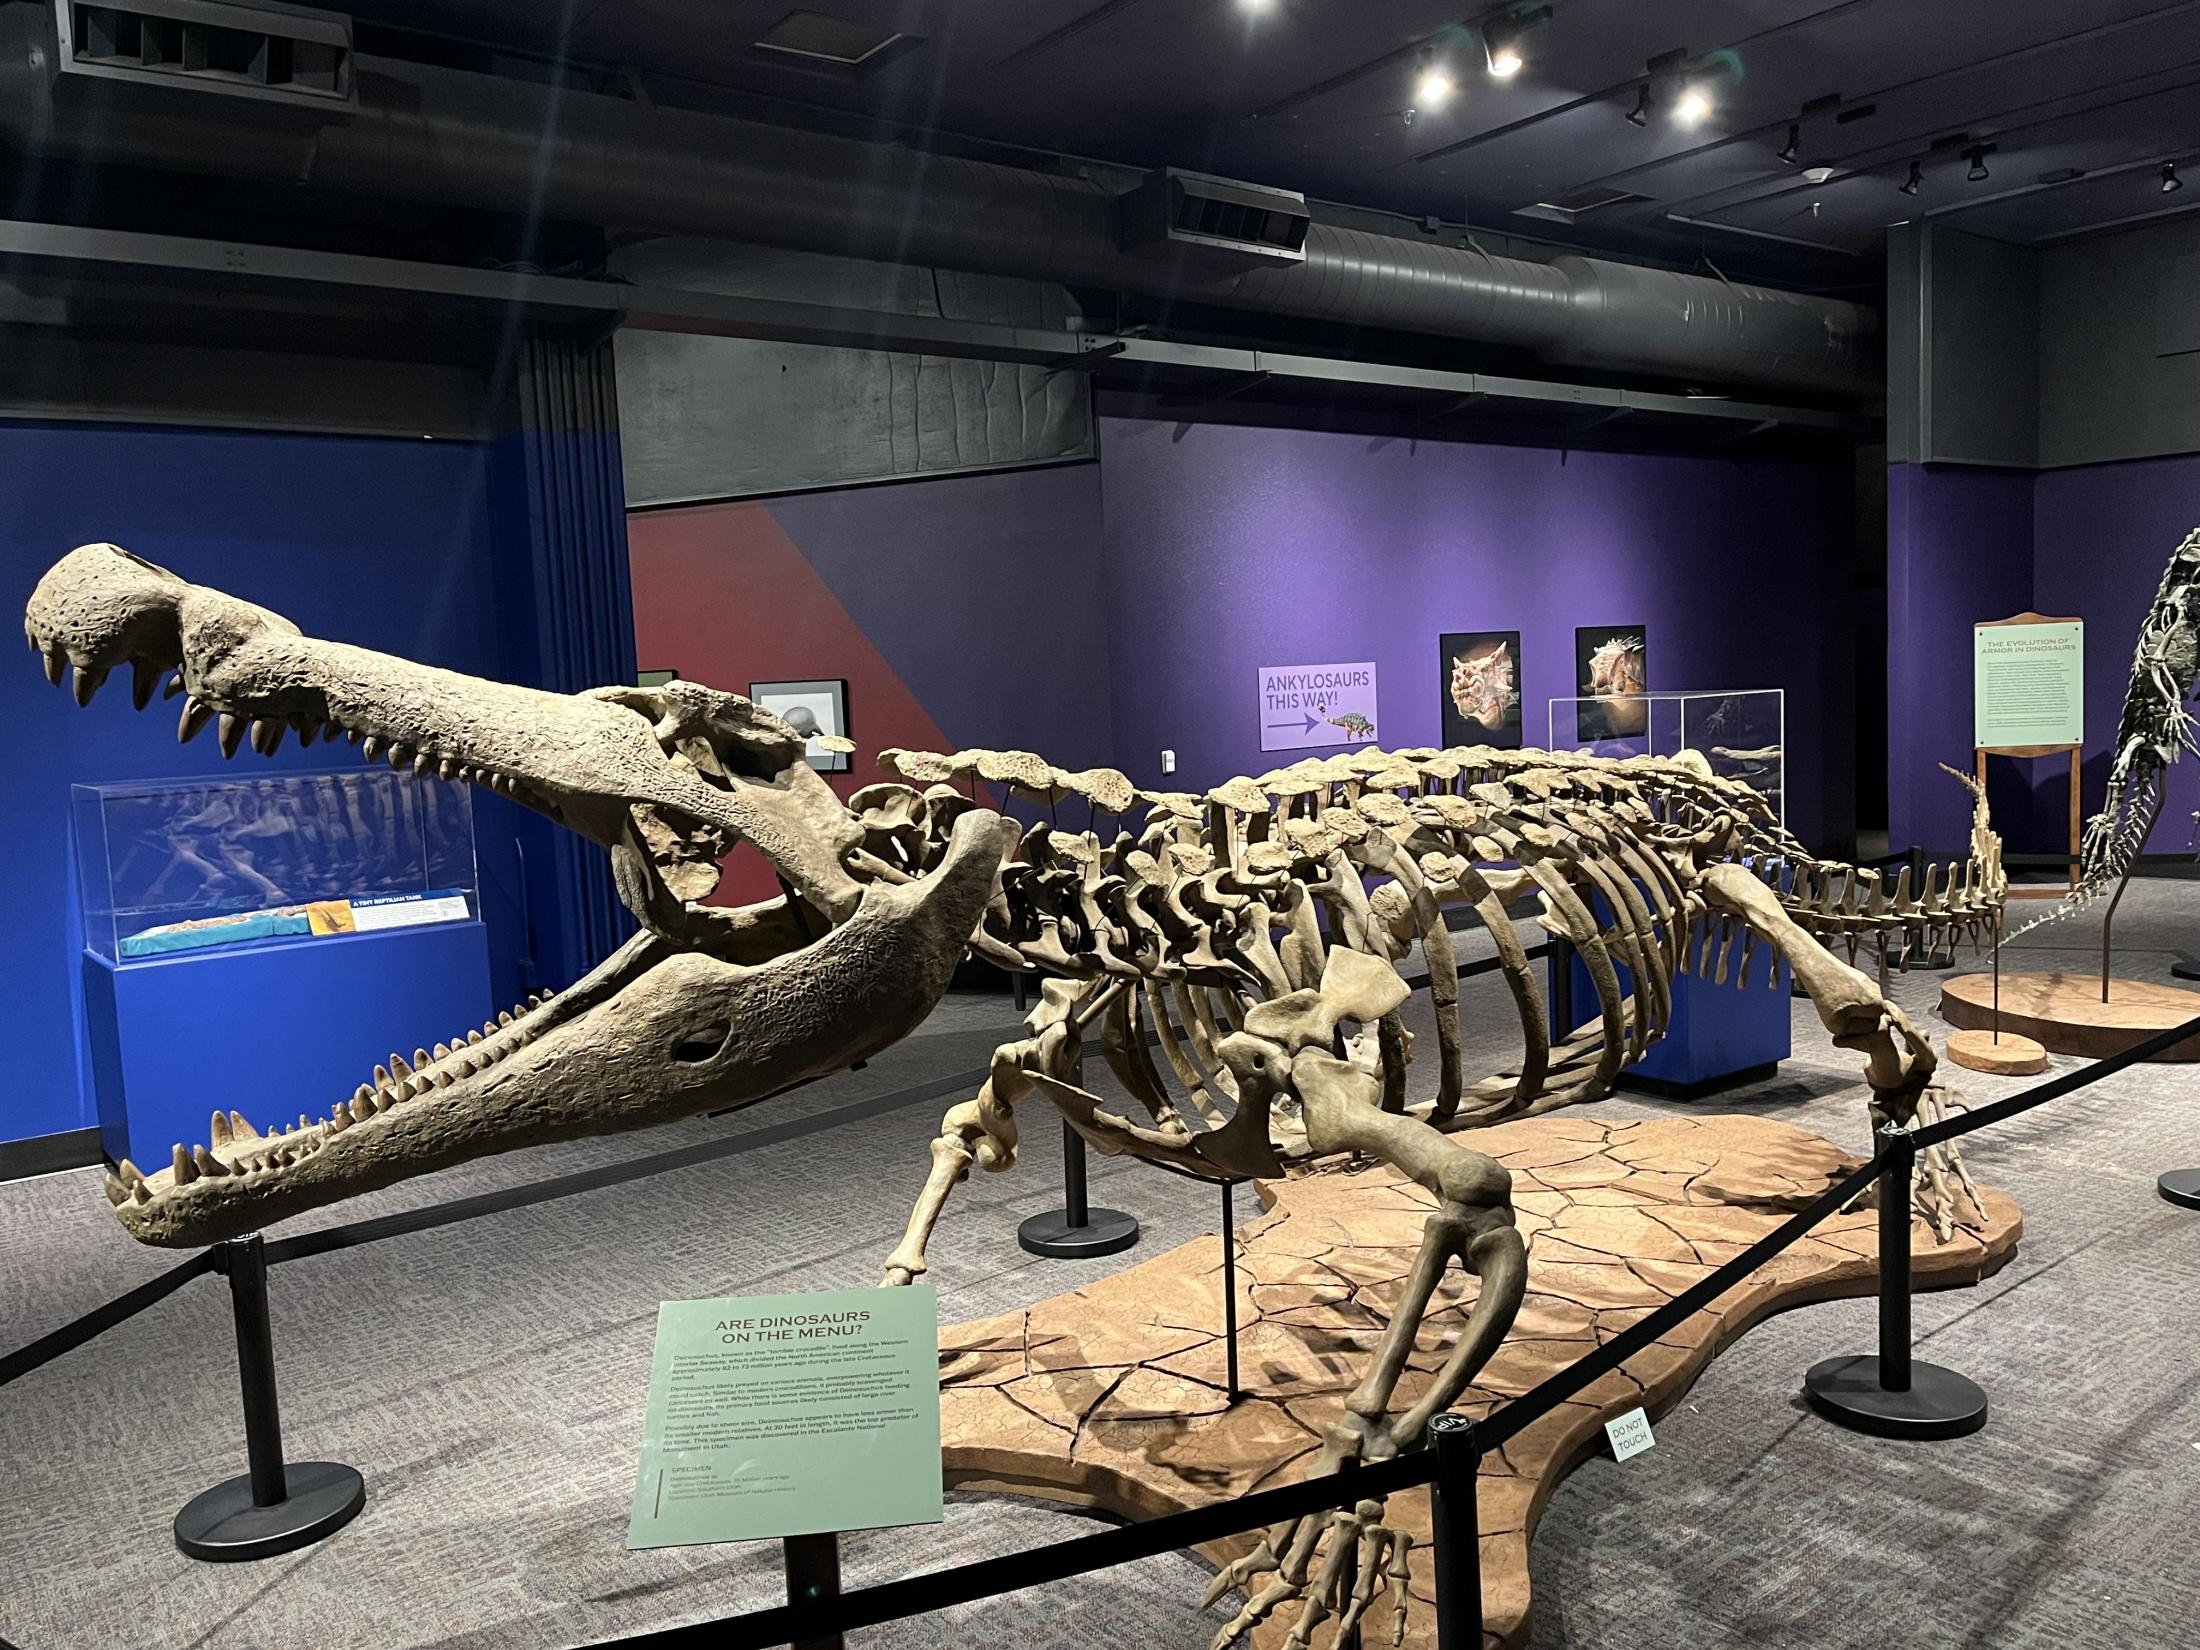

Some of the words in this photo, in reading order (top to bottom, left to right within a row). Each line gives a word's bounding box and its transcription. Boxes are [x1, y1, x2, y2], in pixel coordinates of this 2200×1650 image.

[2026, 645, 2076, 653] DINOSAURS
[1266, 672, 1369, 692] ANKYLOSAURS
[1267, 693, 1299, 710] THIS
[1302, 691, 1338, 707] WAY!
[716, 1319, 755, 1330] ARE
[760, 1311, 869, 1327] DINOSAURS
[722, 1333, 750, 1343] ON
[755, 1330, 793, 1341] THE
[798, 1325, 861, 1338] MENU?
[1612, 1426, 1626, 1438] DO
[1626, 1417, 1643, 1432] NOT
[1618, 1432, 1648, 1452] TOUCH
